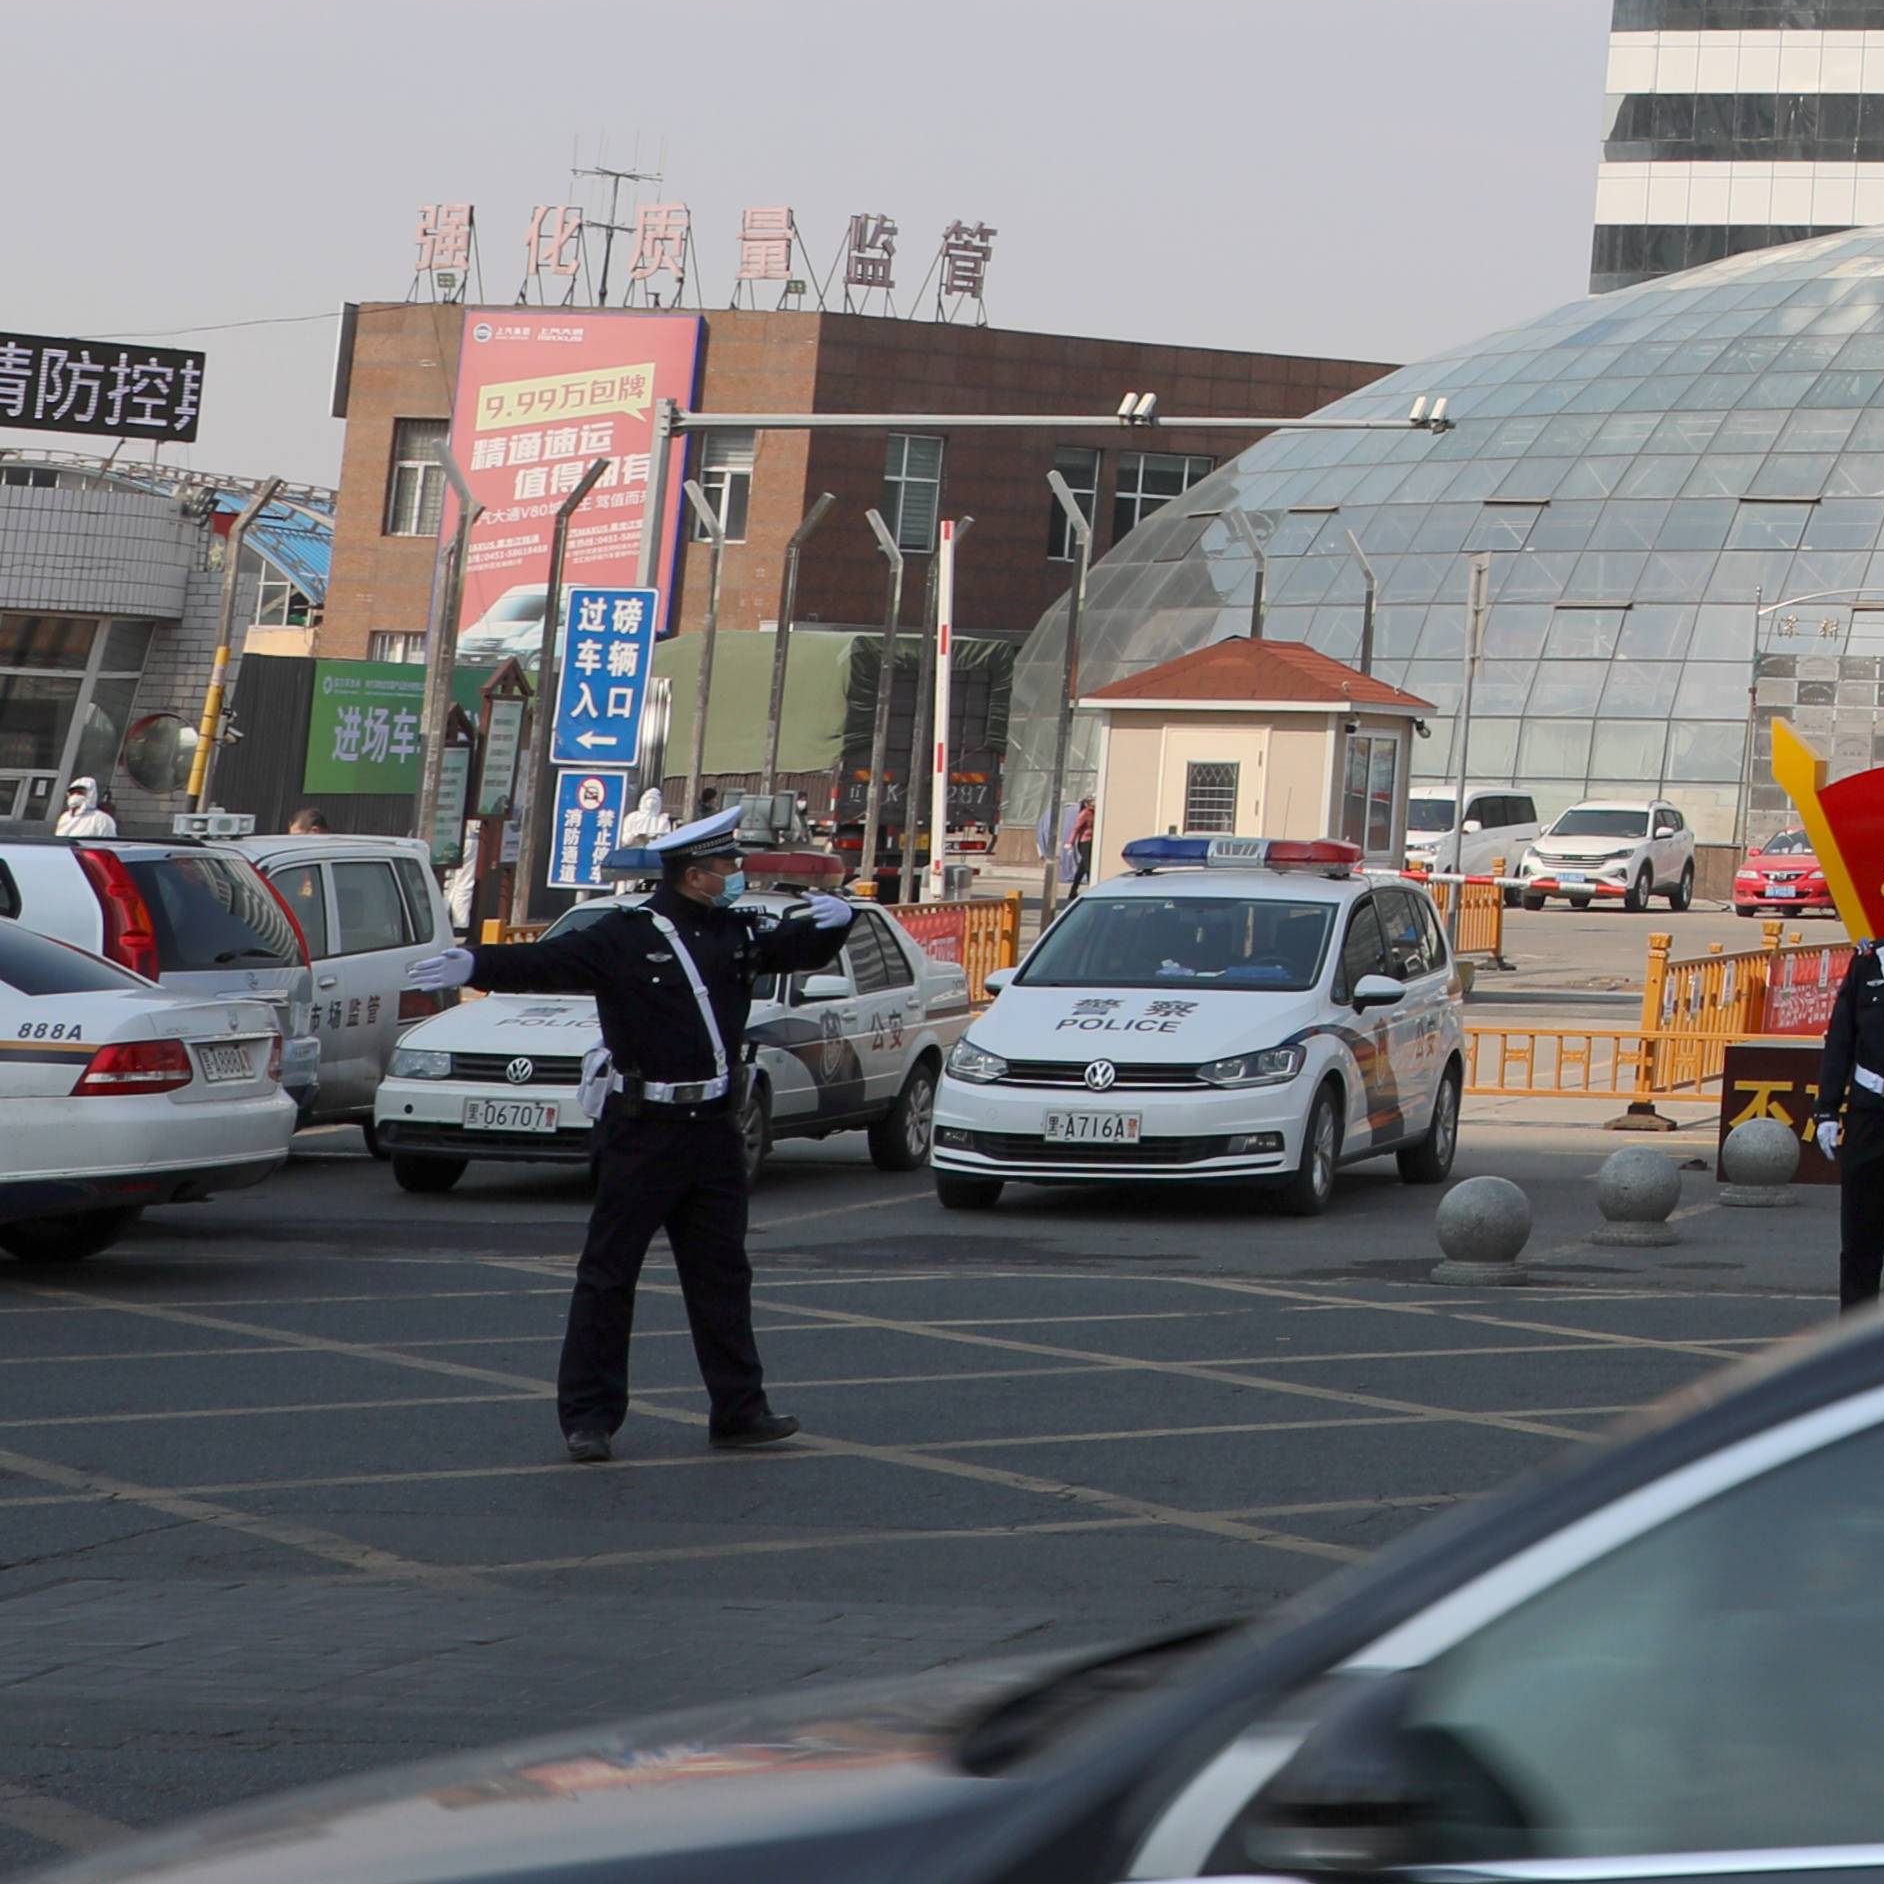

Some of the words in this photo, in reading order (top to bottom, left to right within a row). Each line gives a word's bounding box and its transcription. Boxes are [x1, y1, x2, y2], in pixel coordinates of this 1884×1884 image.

[414, 203, 998, 298] 强化质量监管
[485, 373, 647, 420] 9.99万包牌
[470, 421, 615, 471] 精通速运
[576, 596, 644, 636] 过磅
[573, 638, 640, 677] 车辆
[570, 686, 636, 719] 入口
[558, 808, 583, 884] 消防通道
[18, 1022, 83, 1041] 888A
[496, 1018, 602, 1029] POLIC
[1055, 1018, 1182, 1034] POLICE
